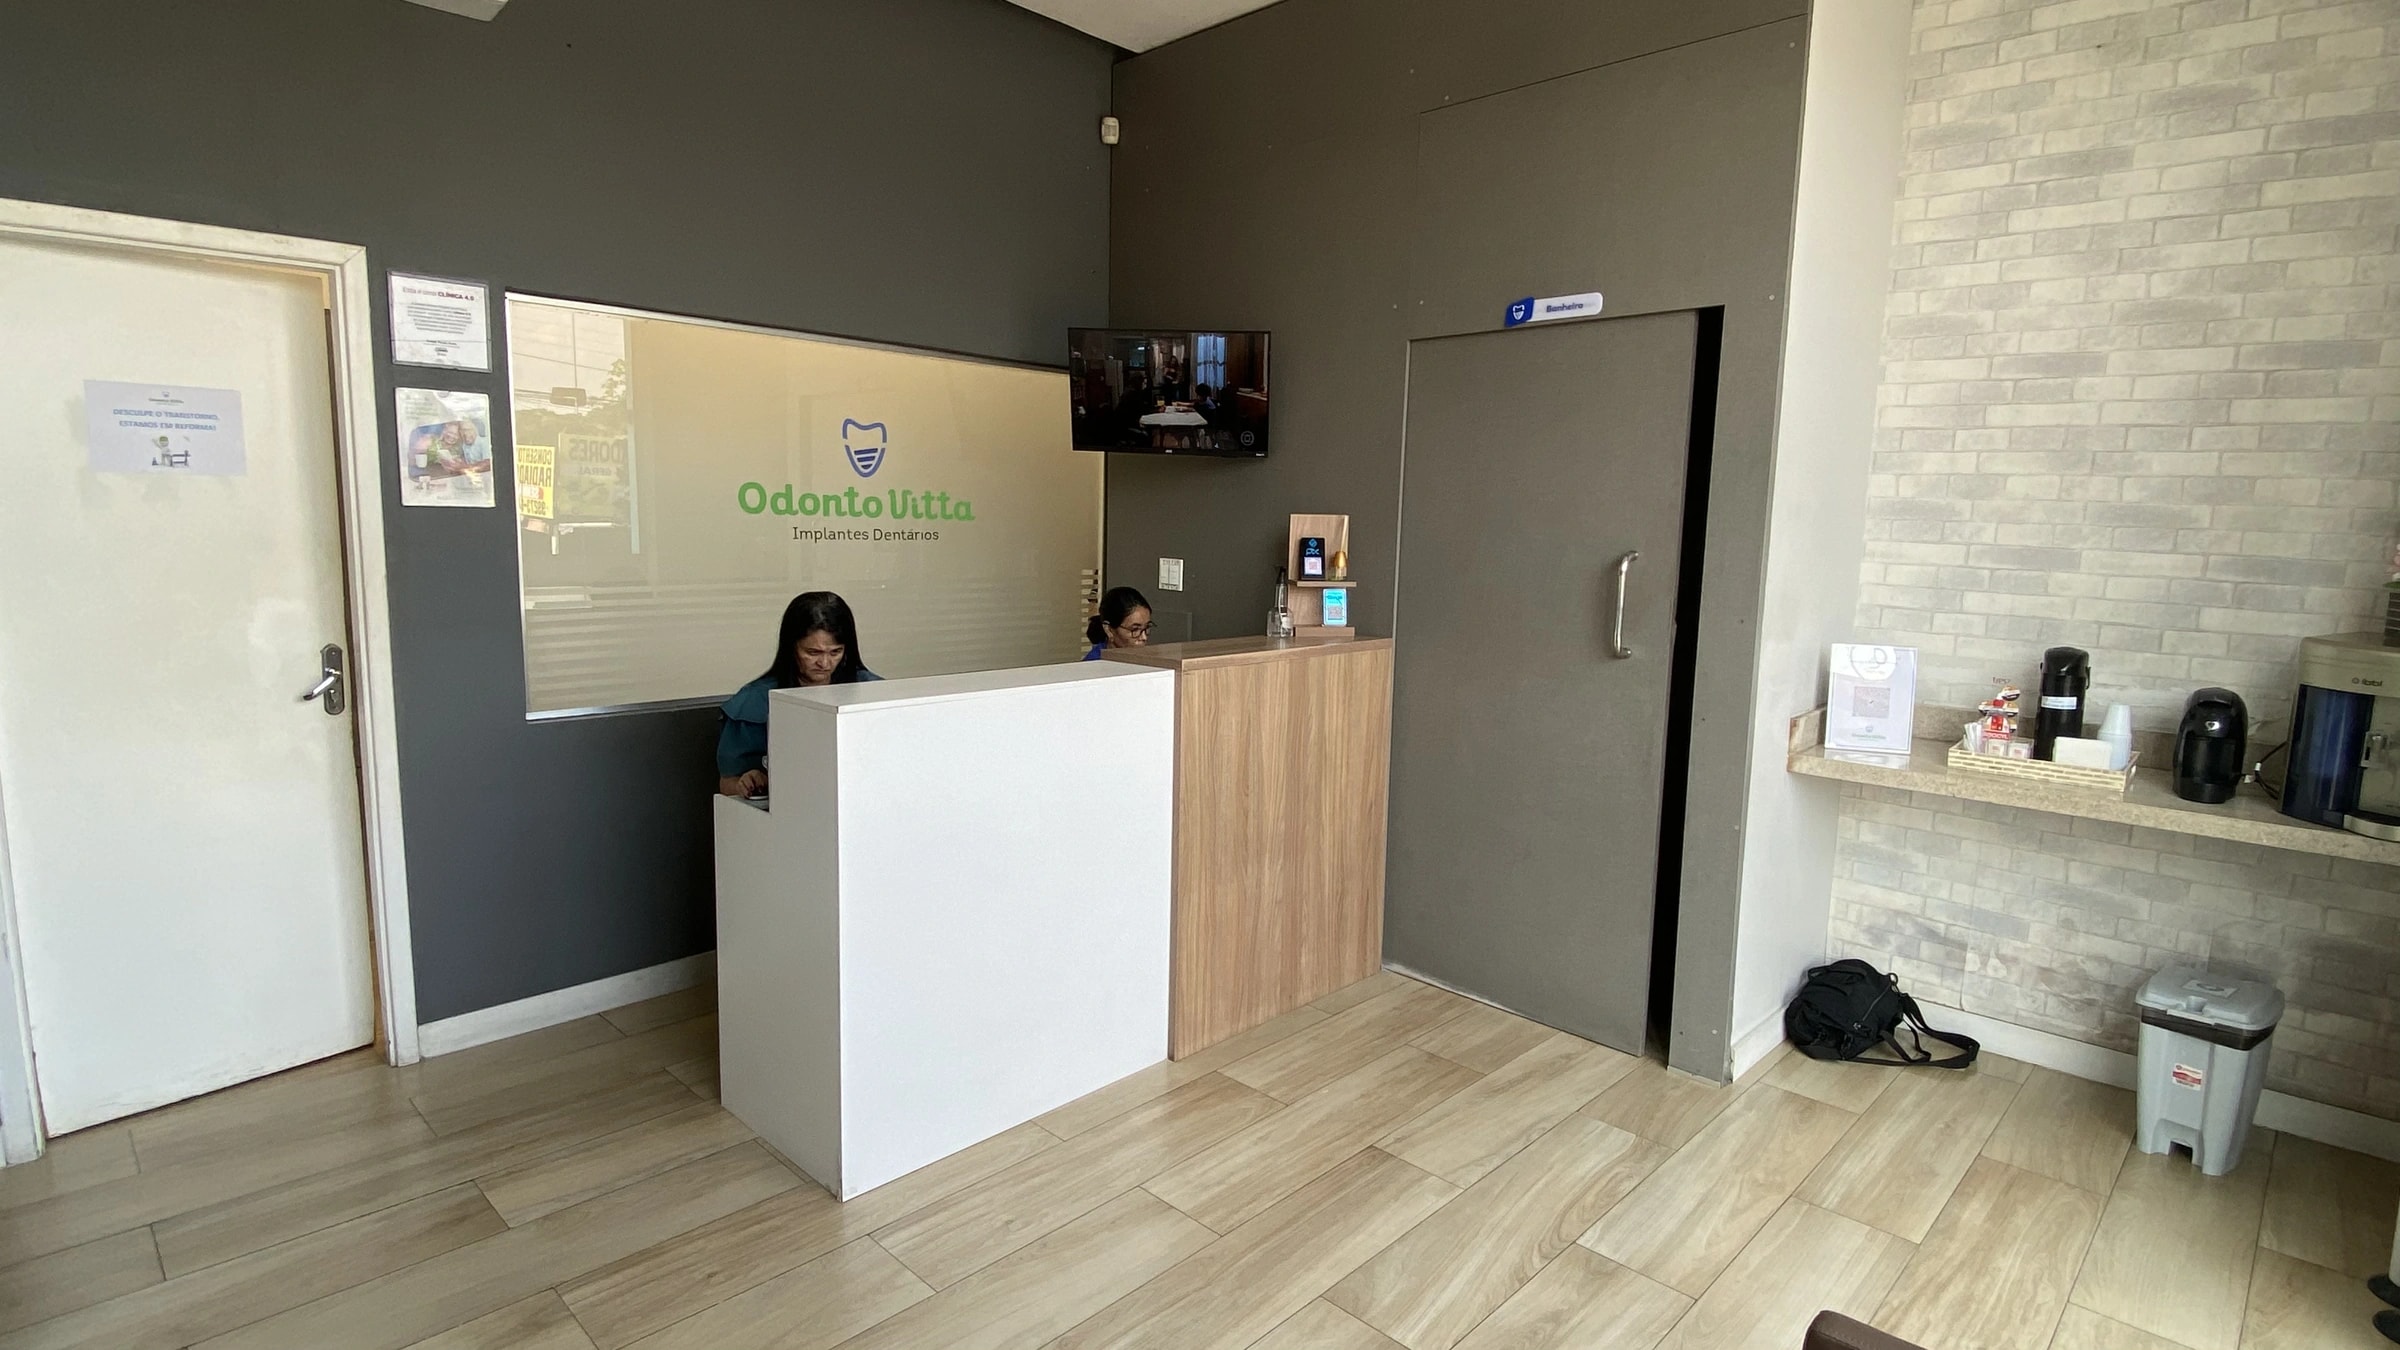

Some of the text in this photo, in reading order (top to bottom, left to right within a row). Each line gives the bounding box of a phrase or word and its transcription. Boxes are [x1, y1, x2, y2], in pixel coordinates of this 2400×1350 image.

[1546, 302, 1584, 312] Banheiro
[738, 481, 976, 521] Odonto Vitta
[792, 526, 940, 544] Implantes Dentários
